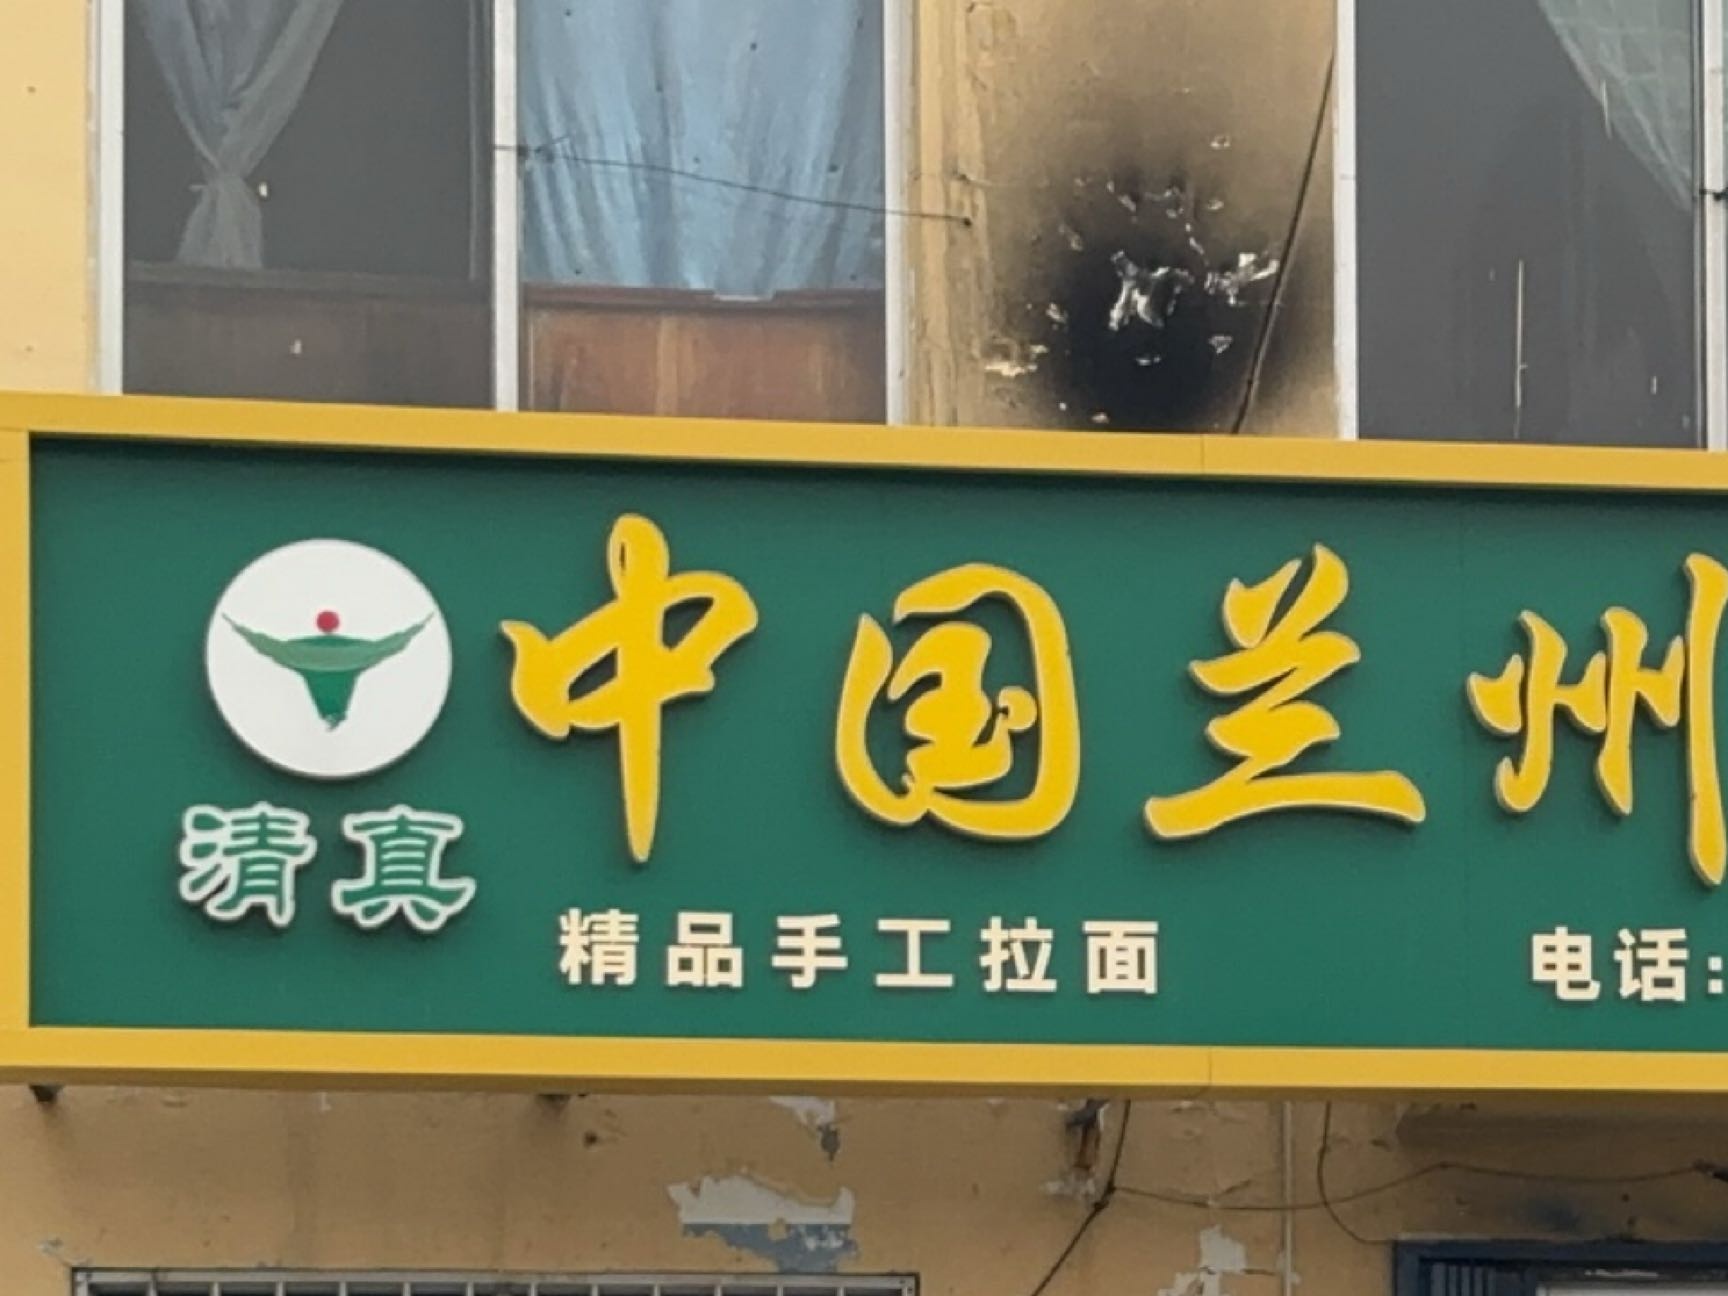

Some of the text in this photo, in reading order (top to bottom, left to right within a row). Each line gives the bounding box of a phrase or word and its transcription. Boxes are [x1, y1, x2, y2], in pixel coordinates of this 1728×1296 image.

[178, 802, 477, 932] 清真
[558, 908, 1161, 996] 精品手工拉面
